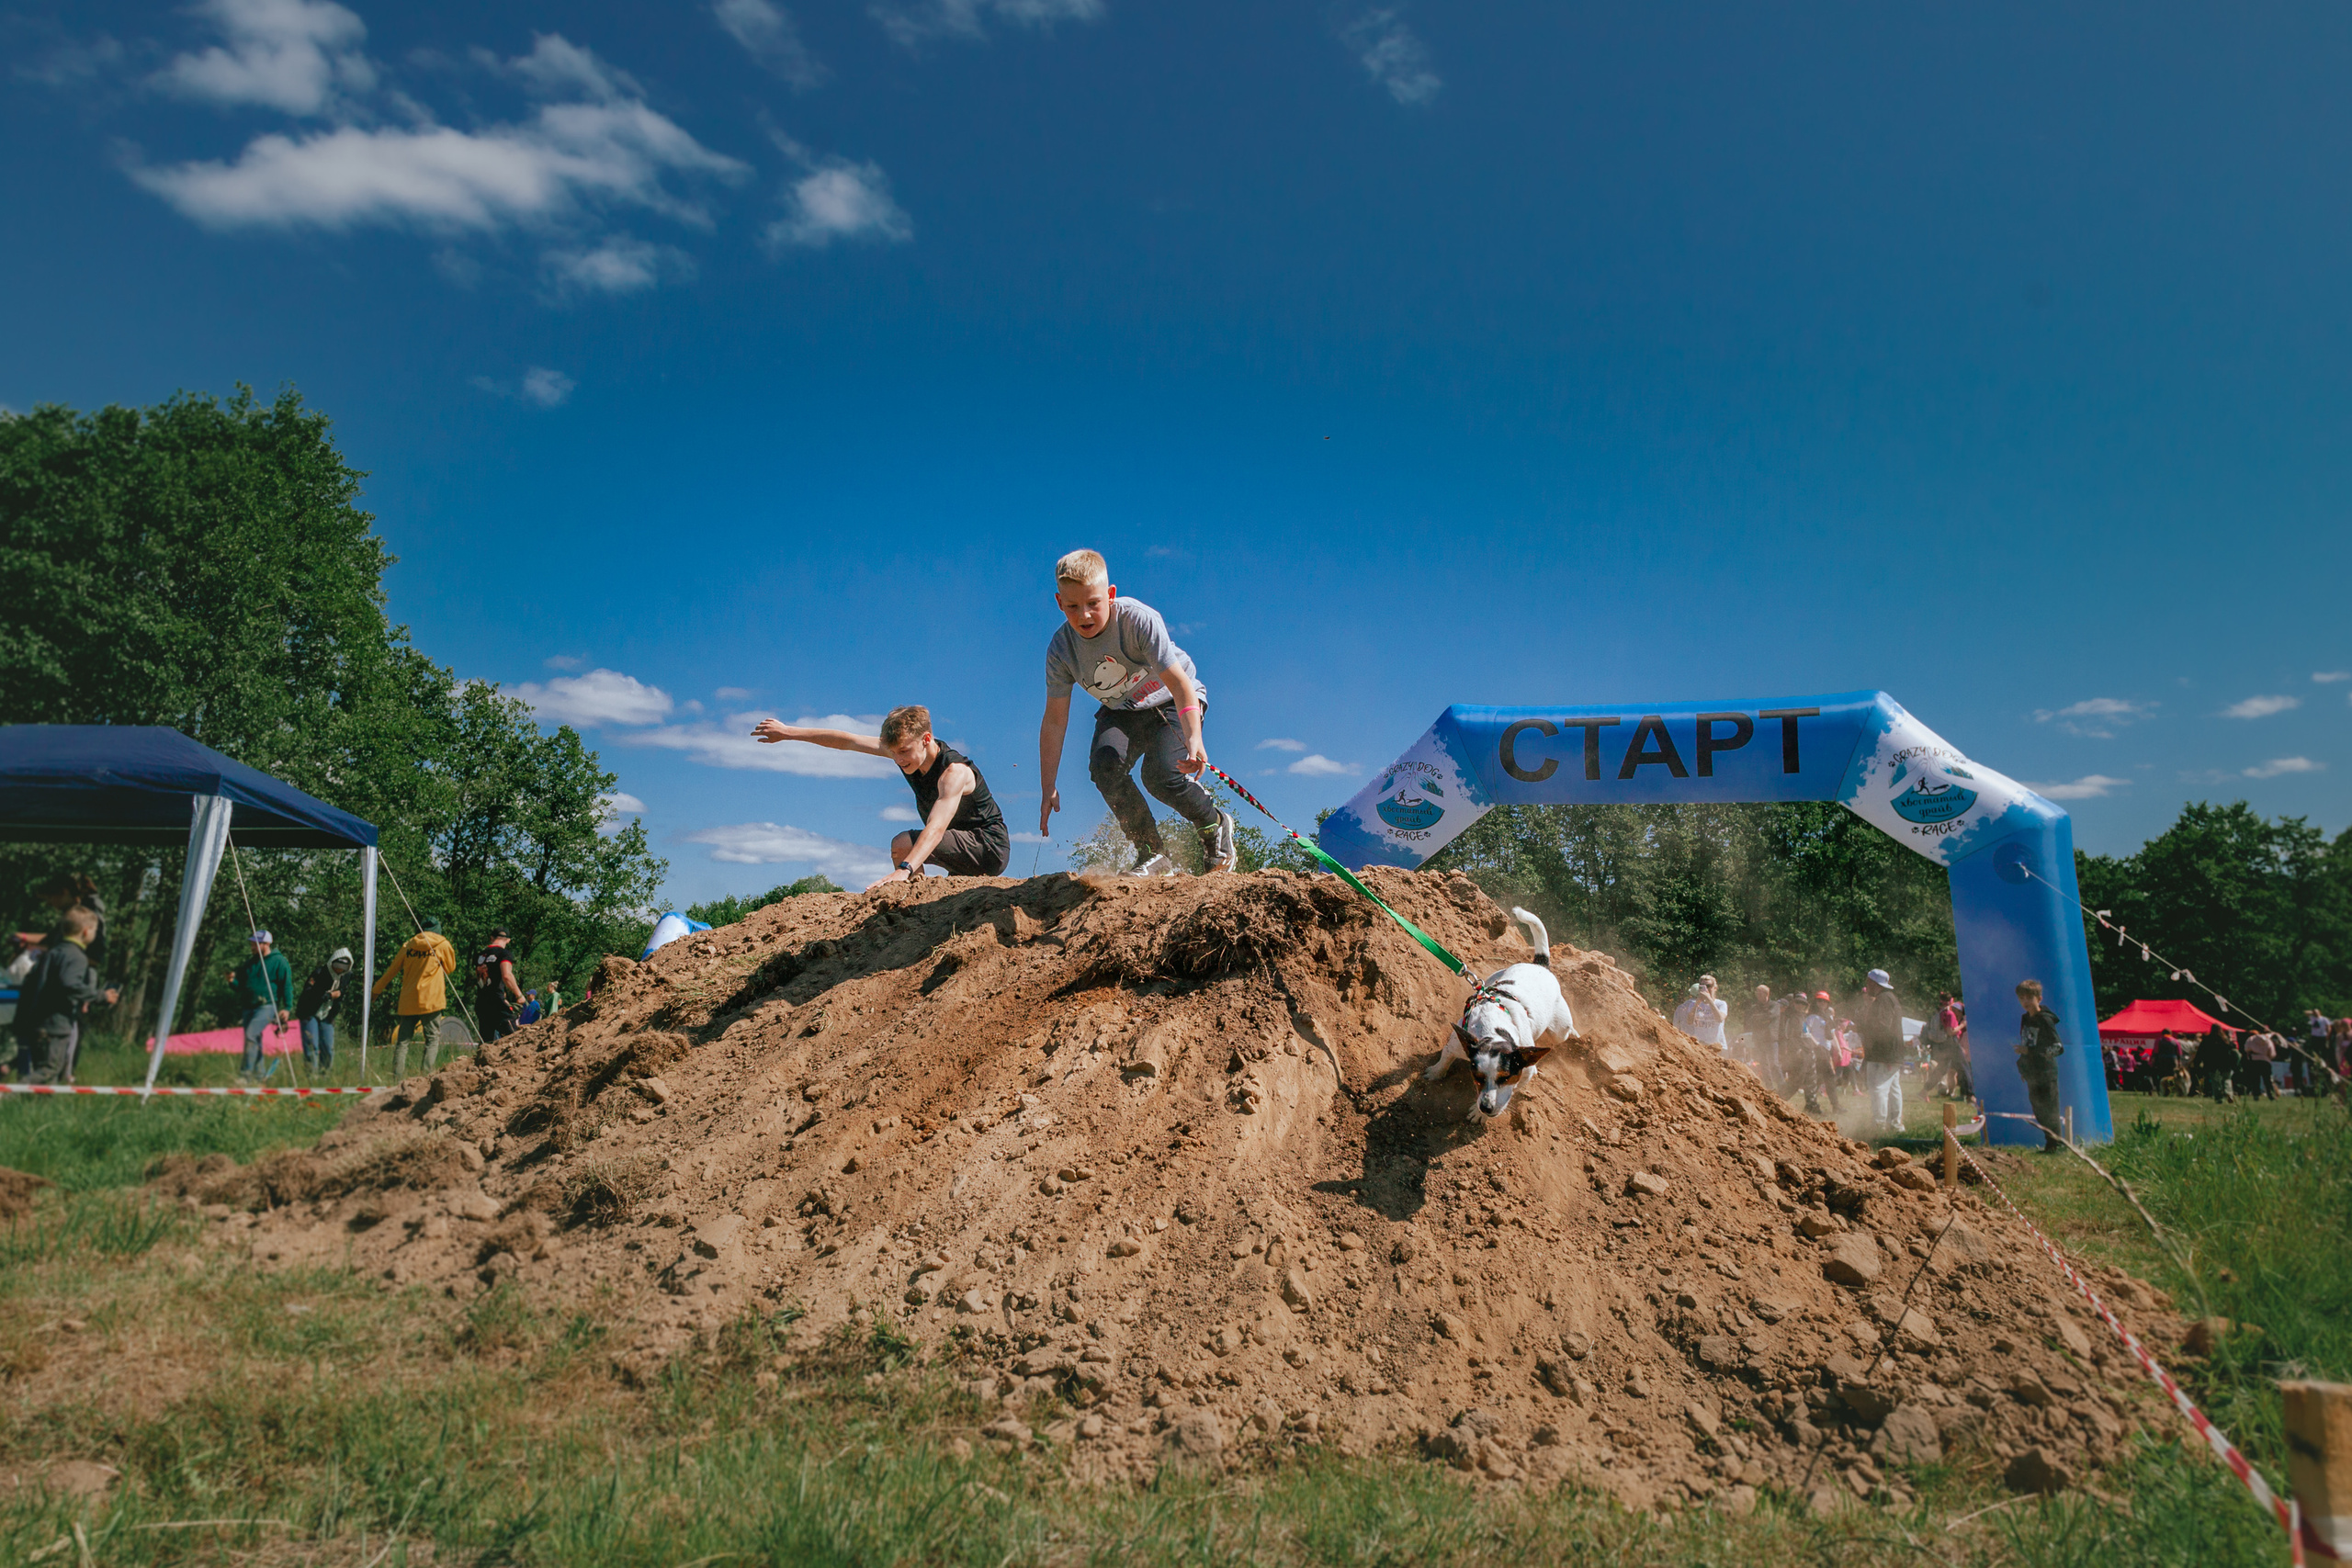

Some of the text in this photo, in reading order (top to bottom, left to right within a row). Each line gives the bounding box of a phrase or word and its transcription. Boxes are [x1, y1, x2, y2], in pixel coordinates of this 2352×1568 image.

[1132, 680, 1160, 704] БУЛЬ
[1498, 707, 1821, 783] СТАРТ
[1893, 746, 1961, 765] CRAZY DOG
[1388, 761, 1439, 776] CRAZY DOG
[1900, 793, 1967, 808] хвостатый
[1383, 803, 1433, 816] хвостатый
[1918, 805, 1952, 818] драйв
[1395, 815, 1421, 825] драйв
[1395, 830, 1424, 841] RACE
[1921, 822, 1958, 836] RACE
[2100, 1037, 2146, 1046] СТРАЦИЯ
